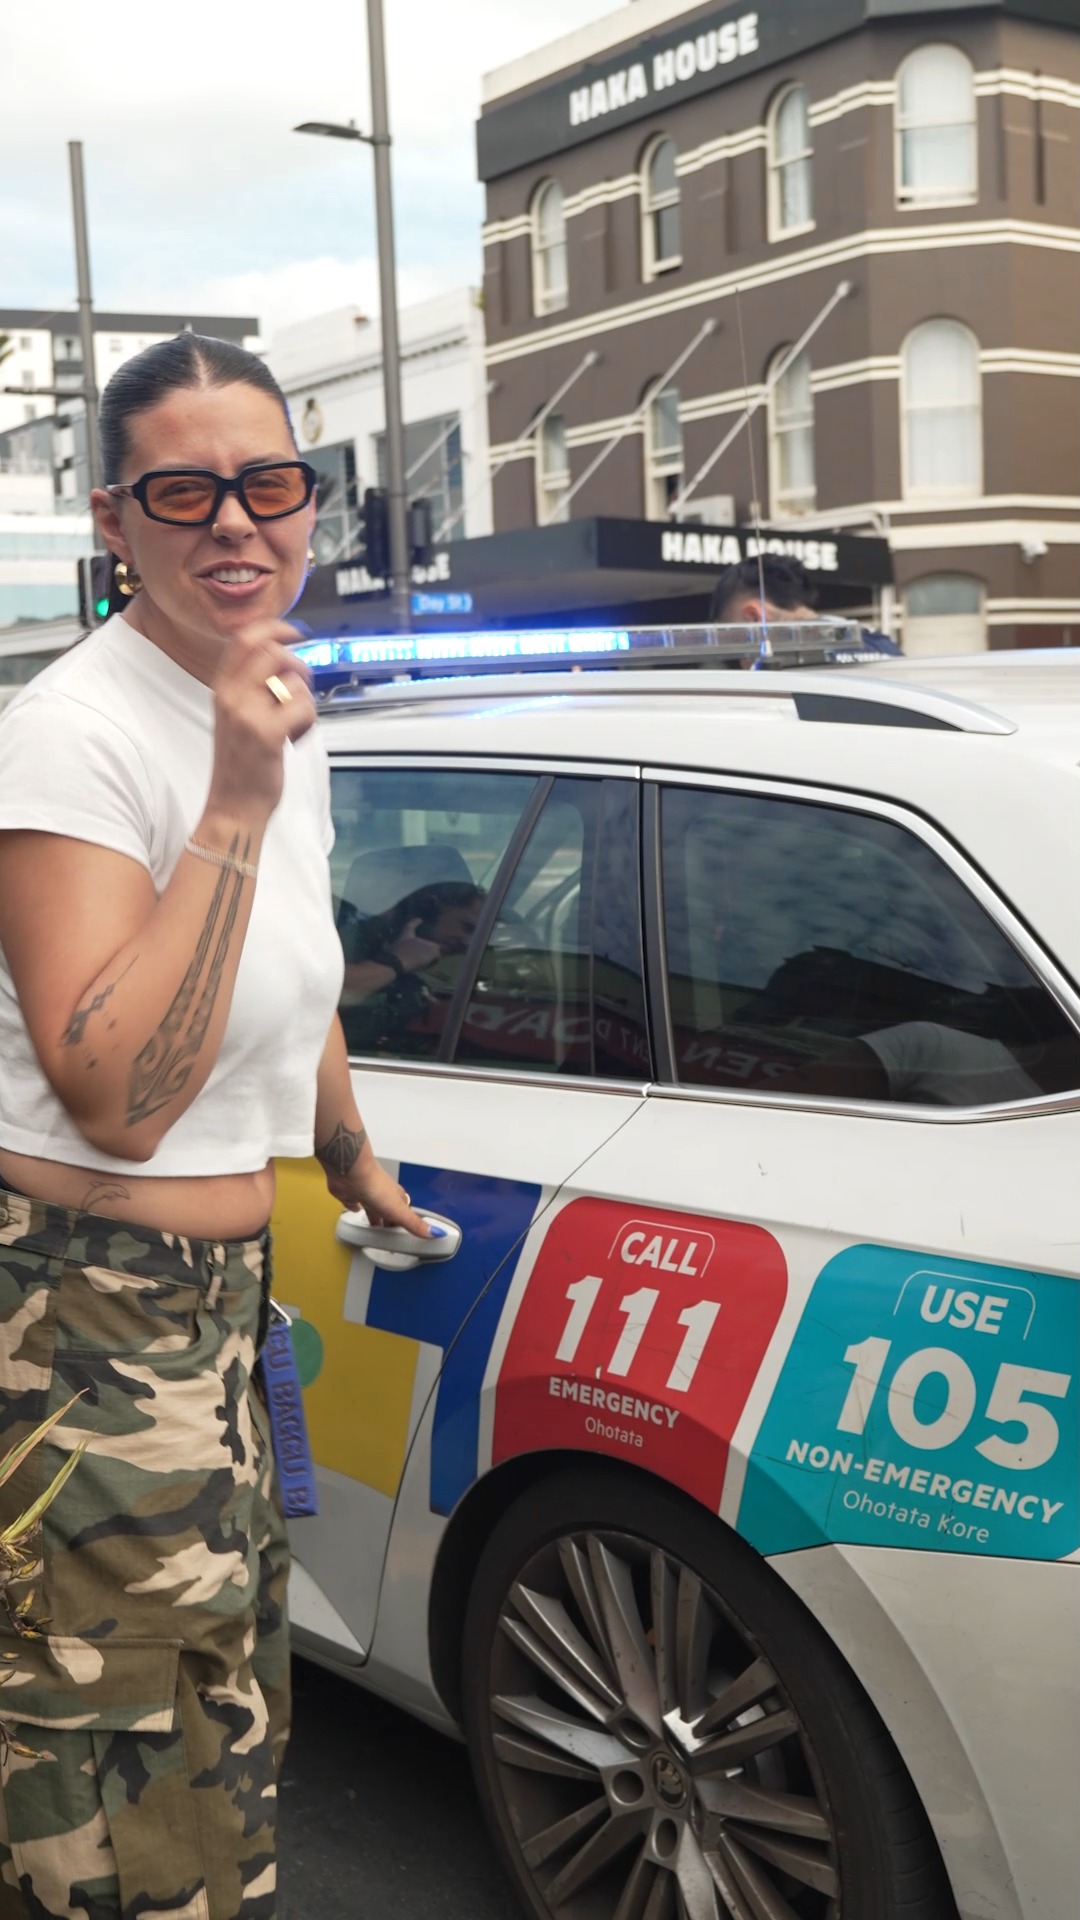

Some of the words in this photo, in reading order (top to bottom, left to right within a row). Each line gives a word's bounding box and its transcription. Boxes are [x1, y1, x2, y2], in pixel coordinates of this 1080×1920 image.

[569, 62, 648, 126] HAKA
[652, 12, 759, 91] HOUSE
[661, 531, 742, 565] HAKA
[620, 1231, 698, 1276] CALL
[555, 1275, 722, 1393] 111
[920, 1284, 1009, 1335] USE
[549, 1376, 680, 1429] EMERGENCY
[836, 1336, 1072, 1470] 105
[584, 1416, 643, 1448] Ohotata
[785, 1439, 1064, 1524] NON-EMERGENCY
[842, 1490, 931, 1529] Ohotata
[937, 1513, 990, 1544] Kore
